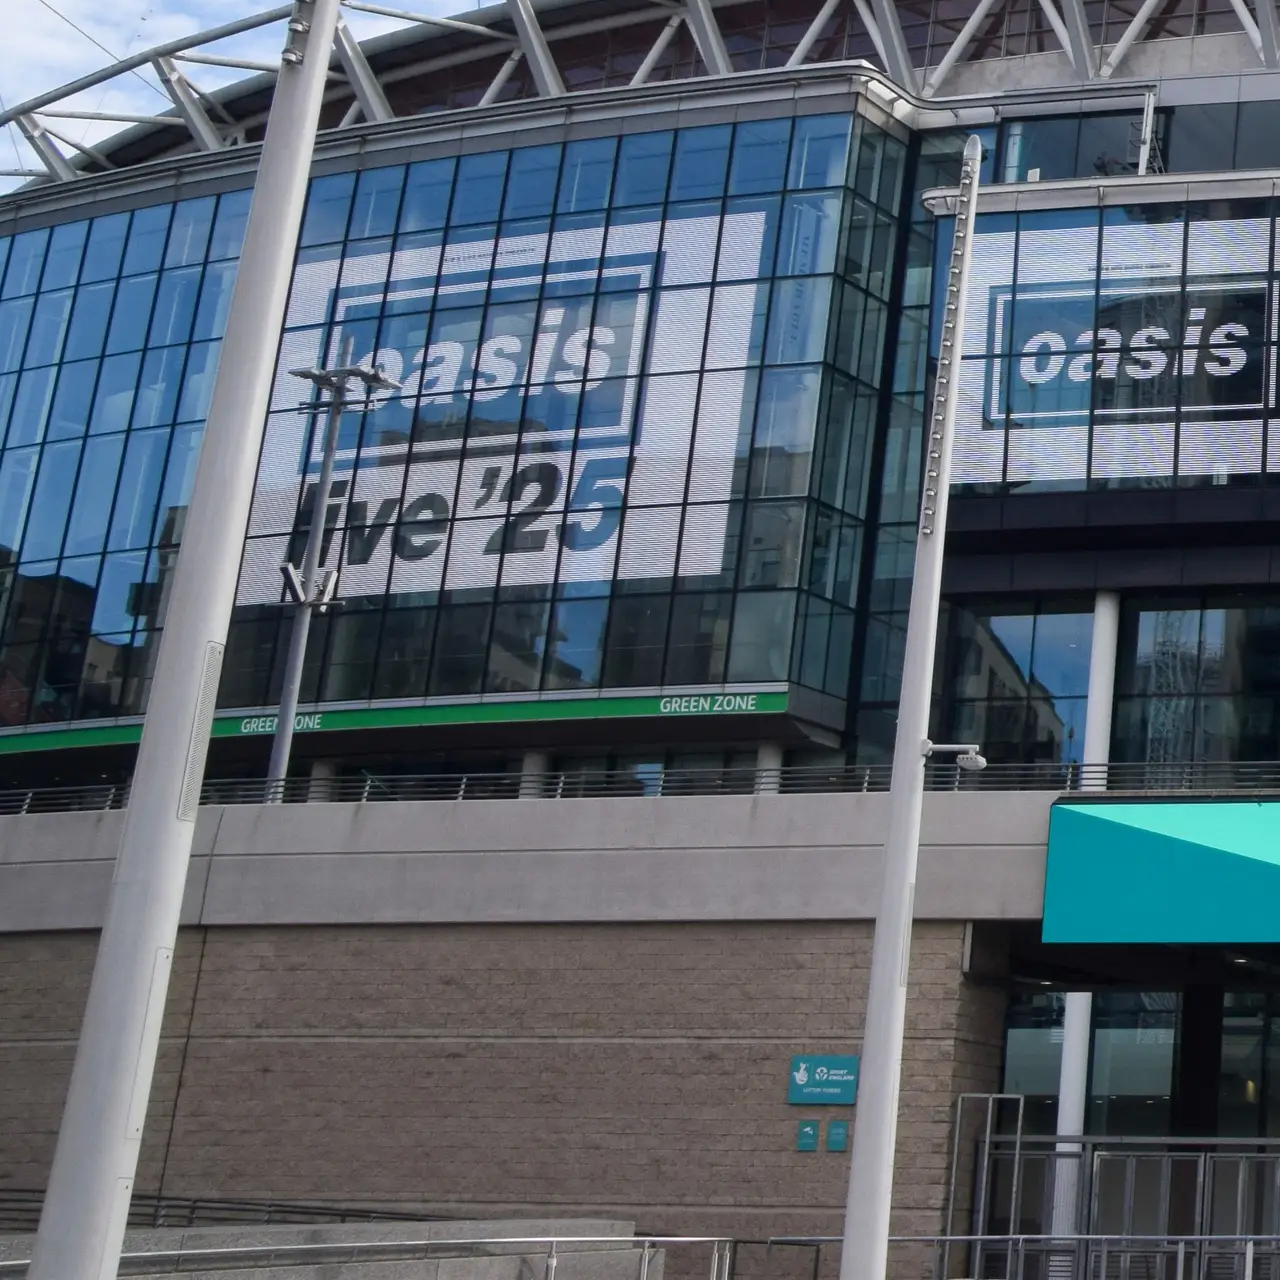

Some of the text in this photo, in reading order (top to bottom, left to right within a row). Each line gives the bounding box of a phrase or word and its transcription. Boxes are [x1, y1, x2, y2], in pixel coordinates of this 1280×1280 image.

[1019, 308, 1248, 383] oasis
[660, 695, 757, 712] GREEN ZONE
[293, 714, 322, 730] ONE
